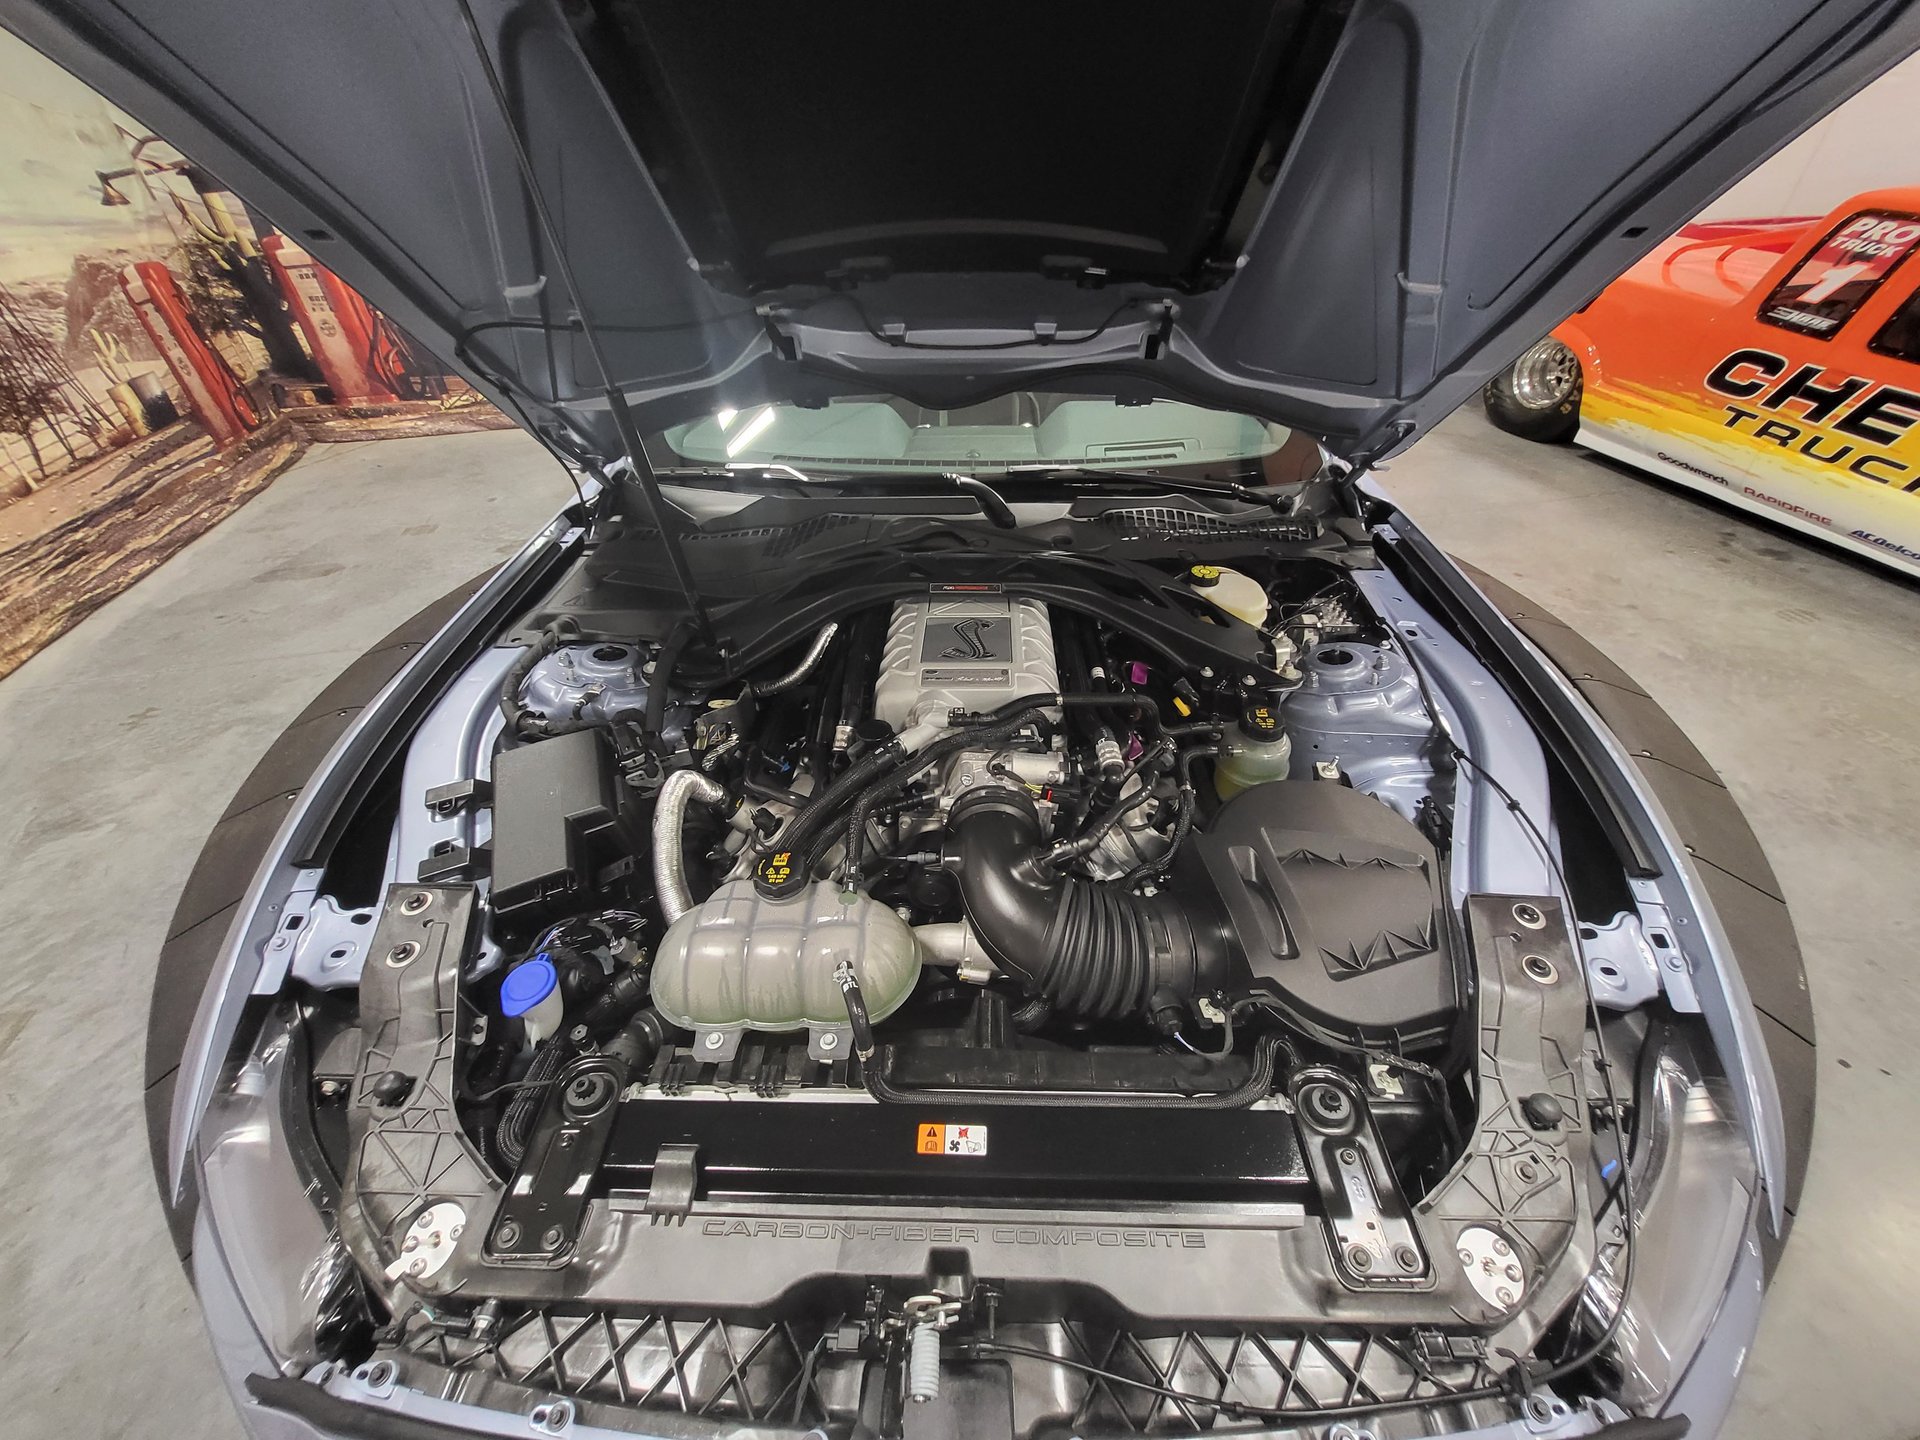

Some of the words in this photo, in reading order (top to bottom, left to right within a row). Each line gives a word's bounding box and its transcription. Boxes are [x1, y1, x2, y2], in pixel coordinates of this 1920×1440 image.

[1841, 216, 1920, 244] PRO
[1829, 235, 1904, 258] TRUCK
[1796, 260, 1875, 305] 1
[701, 1219, 979, 1243] CARBON-FIBER
[991, 1227, 1207, 1249] COMPOSITE
